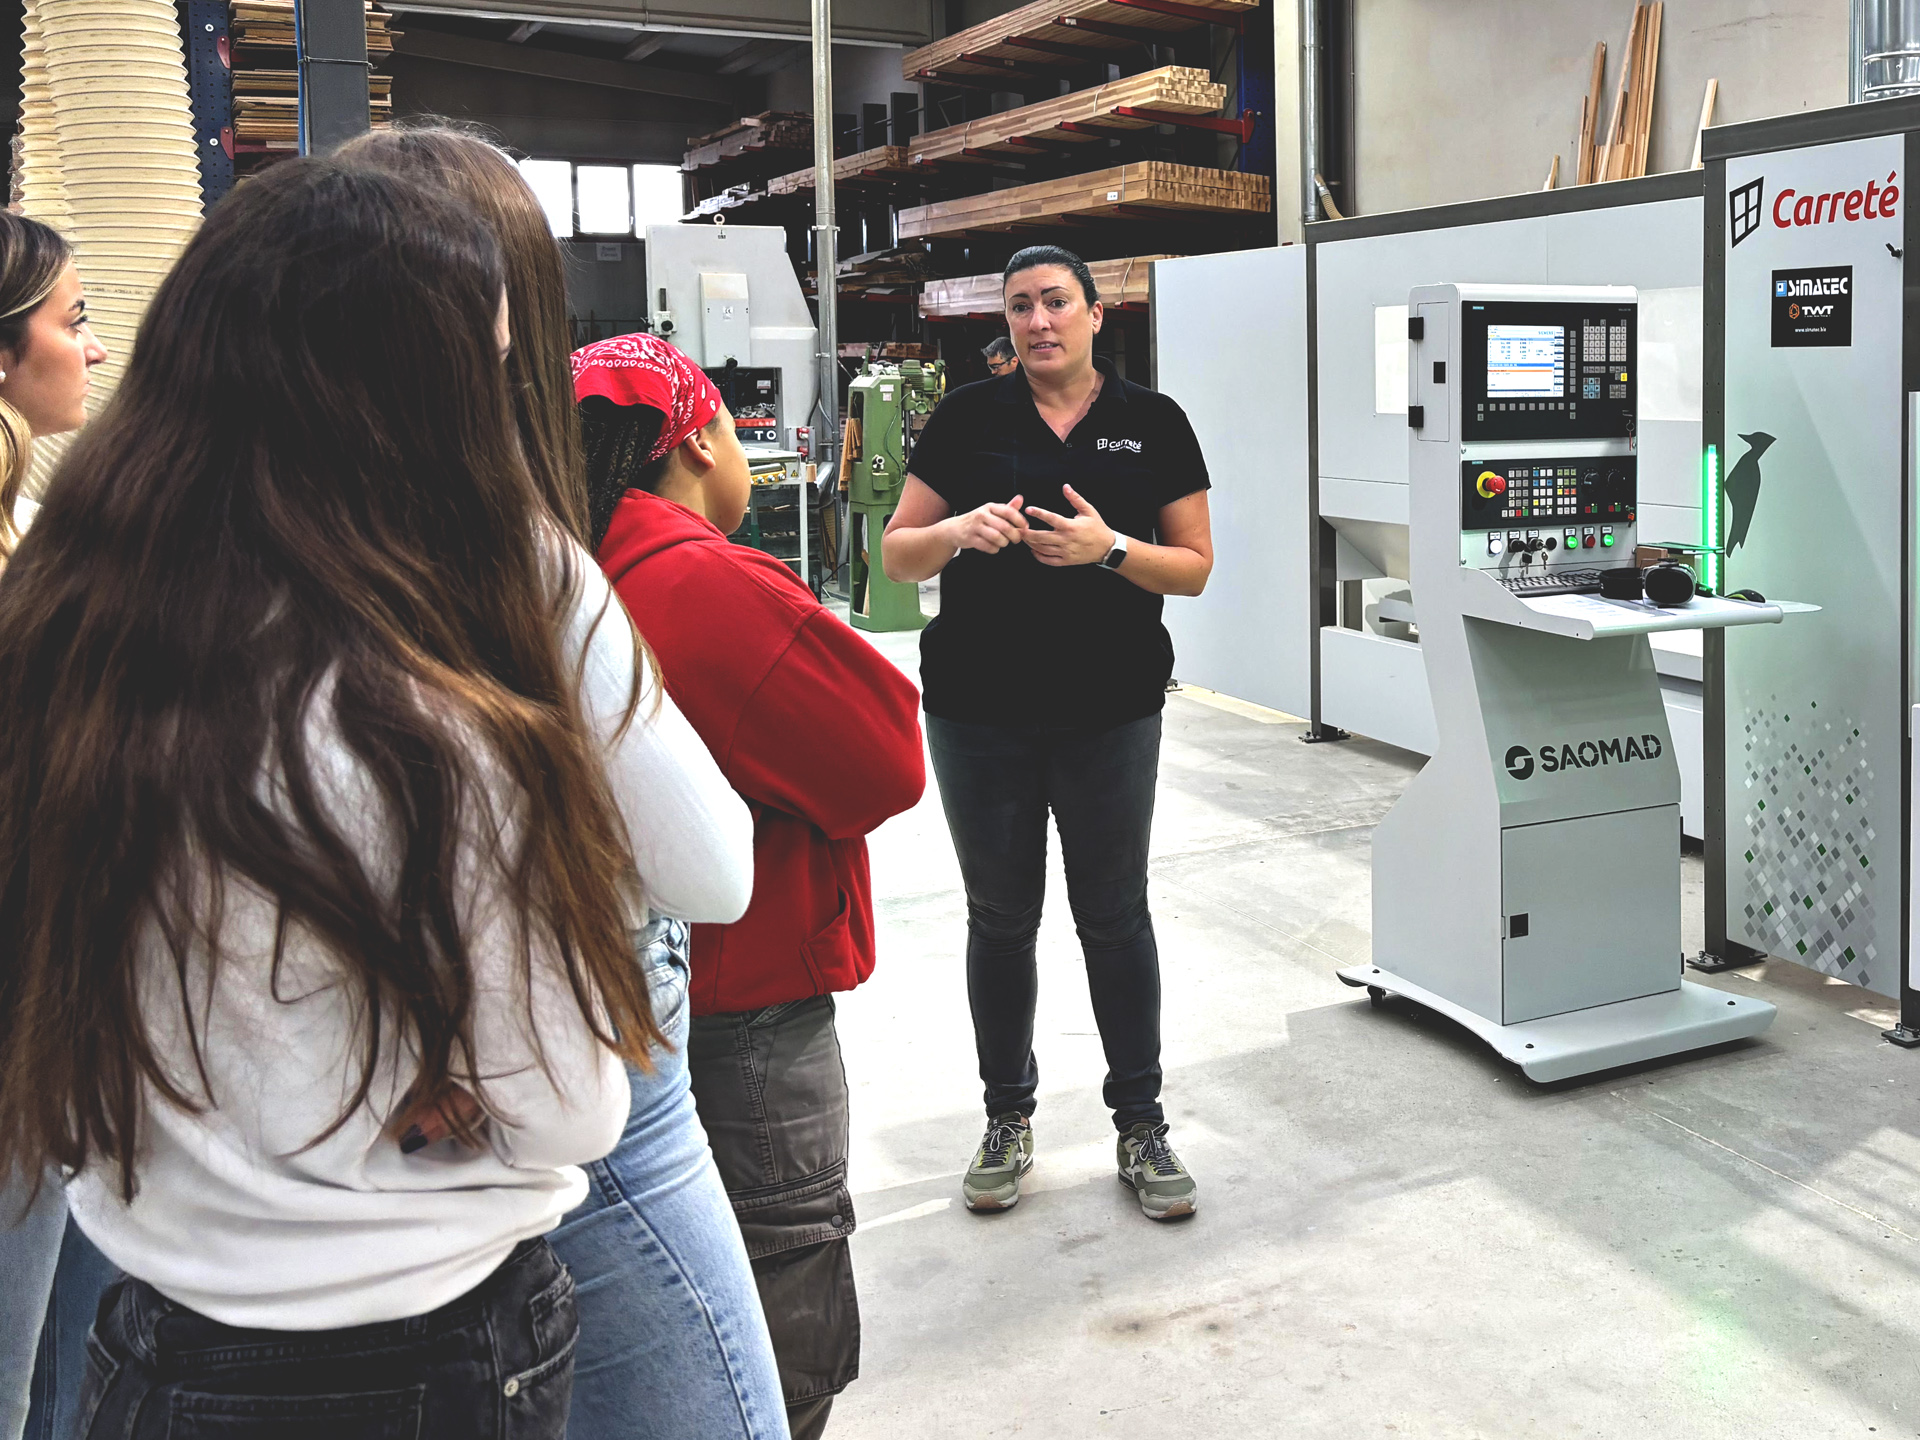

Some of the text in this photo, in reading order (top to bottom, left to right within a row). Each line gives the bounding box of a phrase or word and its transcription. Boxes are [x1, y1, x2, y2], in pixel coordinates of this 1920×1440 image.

[1772, 170, 1899, 228] Carreté
[1801, 305, 1834, 315] TWT
[1539, 733, 1663, 773] SAOMAD
